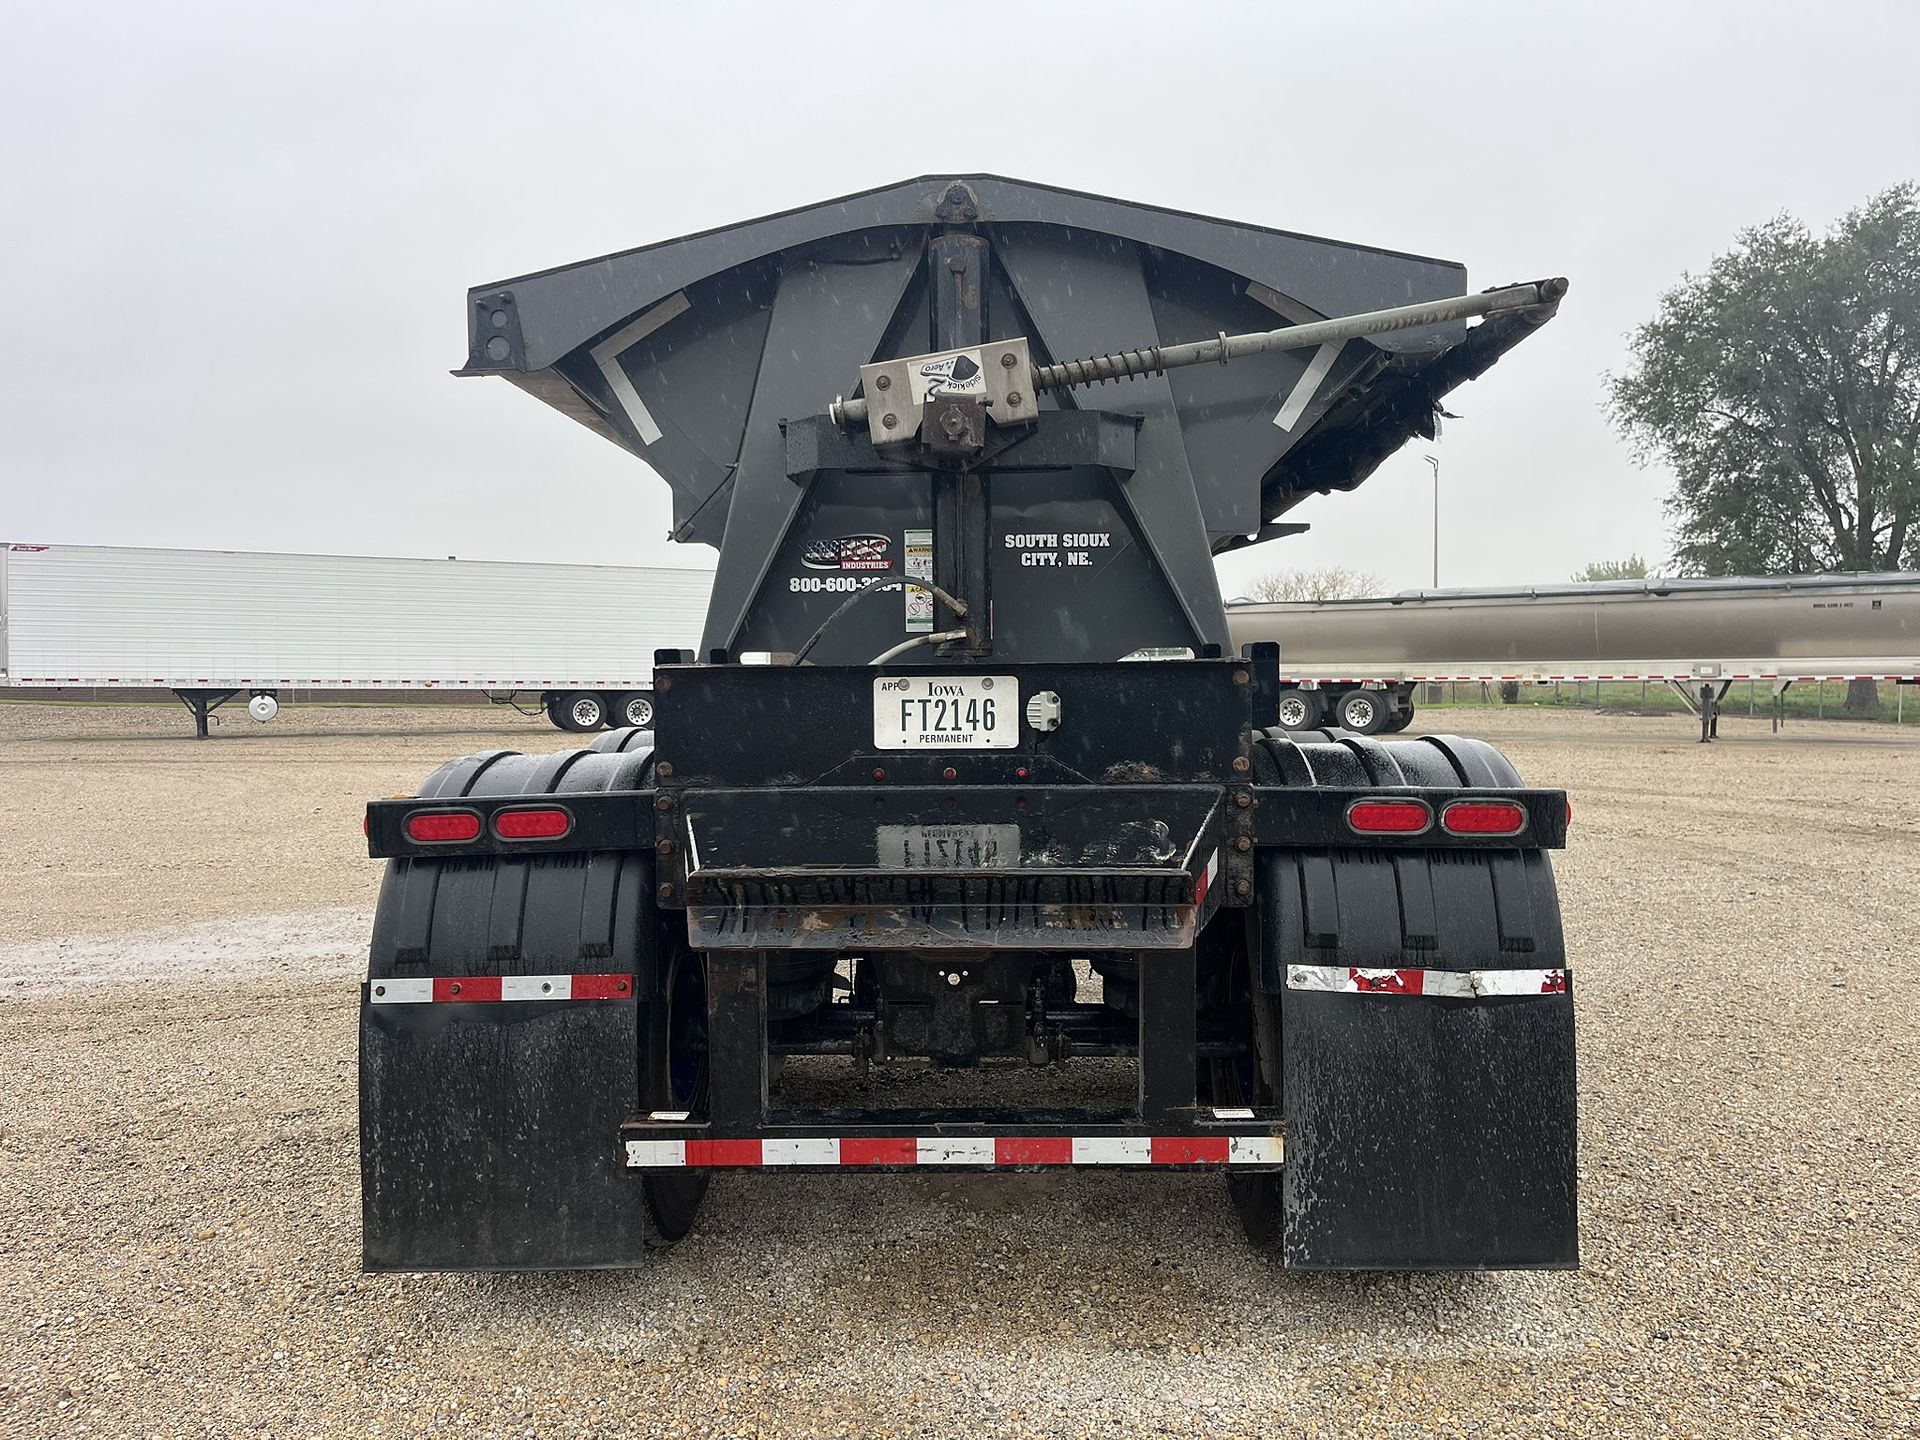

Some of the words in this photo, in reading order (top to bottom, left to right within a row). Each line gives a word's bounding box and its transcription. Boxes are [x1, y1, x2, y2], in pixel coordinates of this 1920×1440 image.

[925, 363, 945, 372] Aero
[947, 374, 982, 391] sidekick
[1005, 534, 1058, 548] SOUTH
[1062, 533, 1110, 547] SIOUX
[842, 561, 889, 569] INDUSTRIES
[1021, 552, 1062, 568] CITY,
[1067, 552, 1093, 566] NE.
[901, 699, 996, 732] FT2146
[919, 735, 973, 743] PERMANENT
